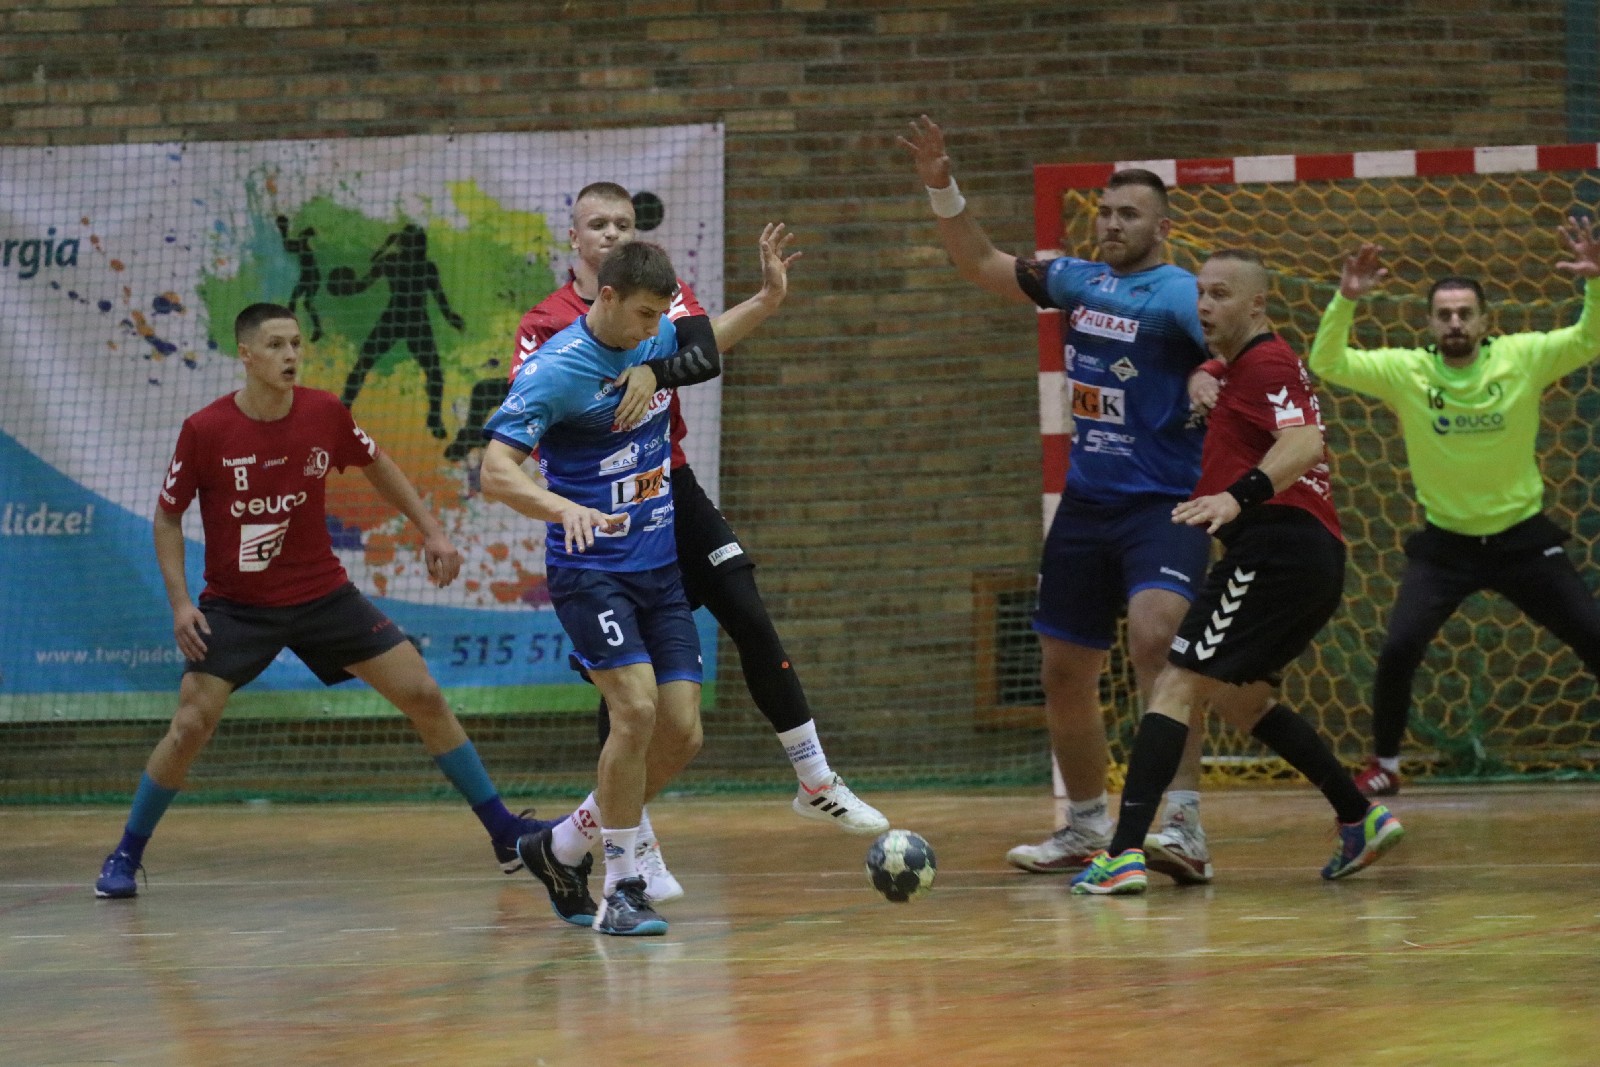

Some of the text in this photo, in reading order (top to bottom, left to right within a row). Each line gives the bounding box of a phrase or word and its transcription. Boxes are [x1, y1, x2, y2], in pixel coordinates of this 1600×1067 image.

[0, 227, 80, 279] rgia
[1085, 313, 1138, 334] HURAS
[222, 453, 257, 468] hummel
[233, 465, 250, 491] 8
[248, 491, 308, 516] euco
[1, 502, 96, 536] lidze!
[597, 609, 625, 647] 5
[450, 633, 516, 667] 515
